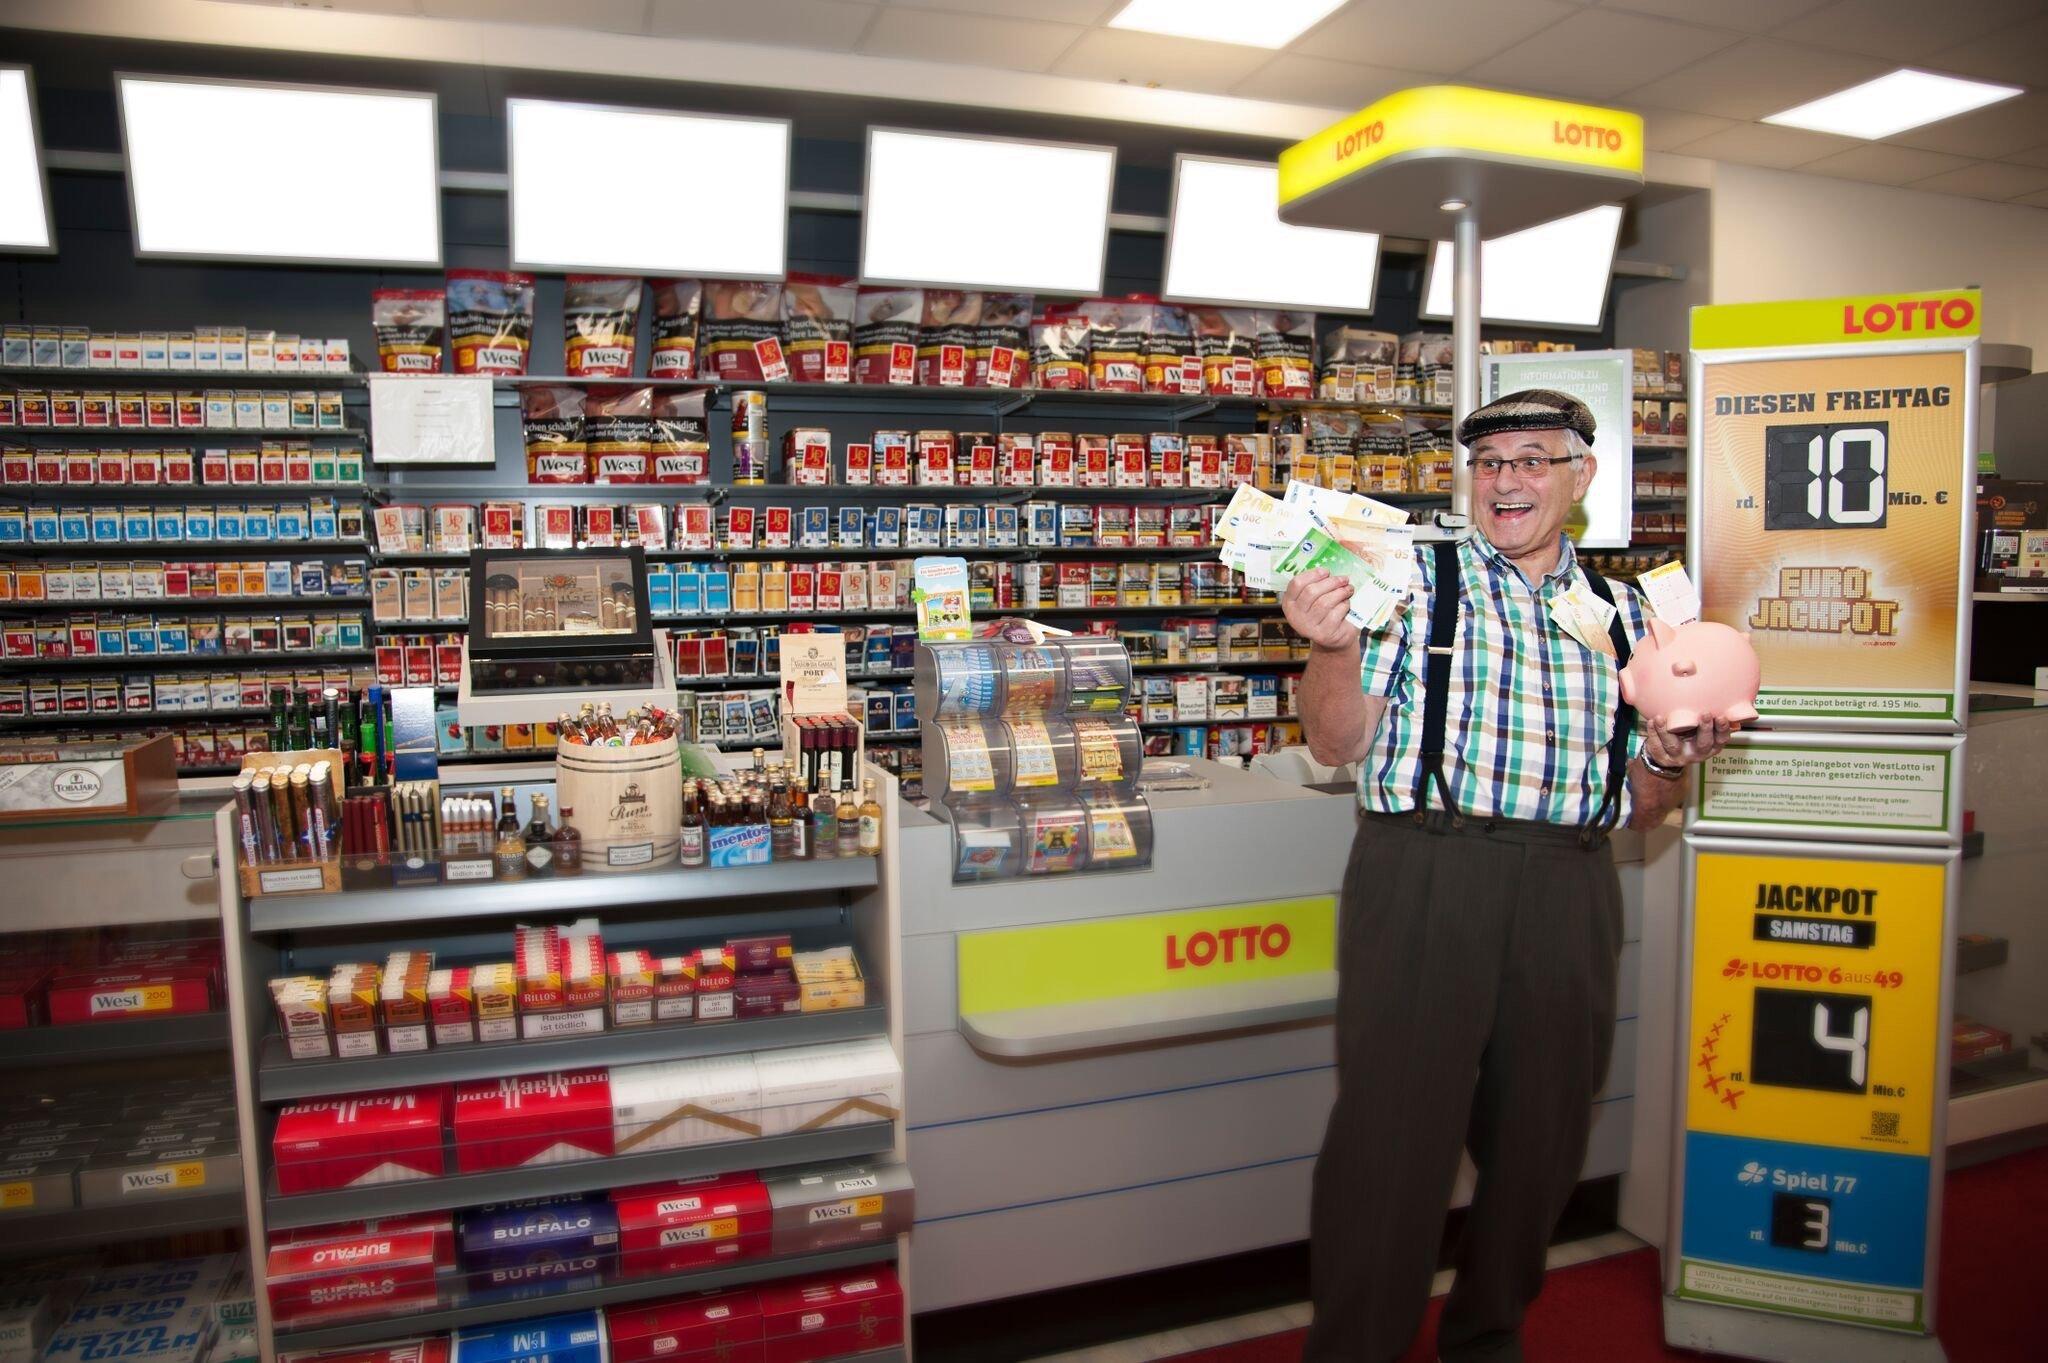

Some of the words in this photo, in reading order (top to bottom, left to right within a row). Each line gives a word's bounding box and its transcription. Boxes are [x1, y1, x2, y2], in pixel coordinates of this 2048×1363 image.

[1336, 120, 1384, 161] LOTTO
[1554, 120, 1622, 152] LOTTO
[1843, 298, 1975, 334] LOTTO
[400, 355, 430, 368] West
[482, 352, 523, 367] West
[586, 351, 626, 366] West
[655, 354, 684, 369] West
[1715, 392, 1816, 416] DIESEN
[1826, 386, 1950, 412] FREITAG
[540, 456, 579, 472] West
[603, 456, 643, 473] West
[660, 455, 700, 473] West
[1736, 496, 1760, 510] rd.
[1807, 428, 1886, 524] 10
[1888, 491, 1928, 506] Mio.
[1935, 490, 1949, 505] €
[1779, 566, 1868, 600] EURO
[1749, 597, 1902, 636] JACKPOT
[803, 669, 825, 677] PORT
[1766, 697, 1780, 707] auf
[1781, 698, 1797, 707] den
[1799, 697, 1833, 709] Jackpot
[1834, 698, 1867, 710] beträgt
[1868, 699, 1880, 709] rd.
[1882, 699, 1901, 709] 195
[1903, 700, 1921, 710] Mio.
[1712, 757, 1727, 765] Die
[1728, 757, 1774, 767] Teilnahme
[1791, 759, 1851, 770] Spielangebot
[1872, 761, 1921, 771] WestLotto
[1922, 762, 1936, 772] ist
[1712, 766, 1754, 776] Personen
[1755, 768, 1780, 777] unter
[1781, 768, 1793, 777] 18
[1794, 769, 1827, 778] Jahren
[1828, 772, 1877, 781] gesetzlich
[1879, 772, 1925, 782] verboten.
[56, 782, 100, 793] TOBAJARA
[710, 824, 771, 850] mentos
[1755, 883, 1879, 916] JACKPOT
[1769, 919, 1854, 944] SAMSTAG
[1166, 922, 1292, 971] LOTTO
[1752, 962, 1823, 983] LOTTO
[96, 993, 140, 1010] West
[542, 1010, 585, 1023] Rauchen
[554, 1019, 588, 1030] tödlich
[1812, 1001, 1869, 1086] 4
[127, 1171, 172, 1188] West
[1772, 1168, 1828, 1191] Spiel
[1833, 1176, 1857, 1194] 77
[661, 1199, 697, 1212] West
[814, 1204, 855, 1219] West
[493, 1217, 592, 1240] BUFFALO
[665, 1227, 707, 1242] West
[1803, 1202, 1830, 1249] 3
[312, 1241, 392, 1264] BUFFALO
[492, 1258, 598, 1283] BUFFALO
[310, 1277, 395, 1305] BUFFALO
